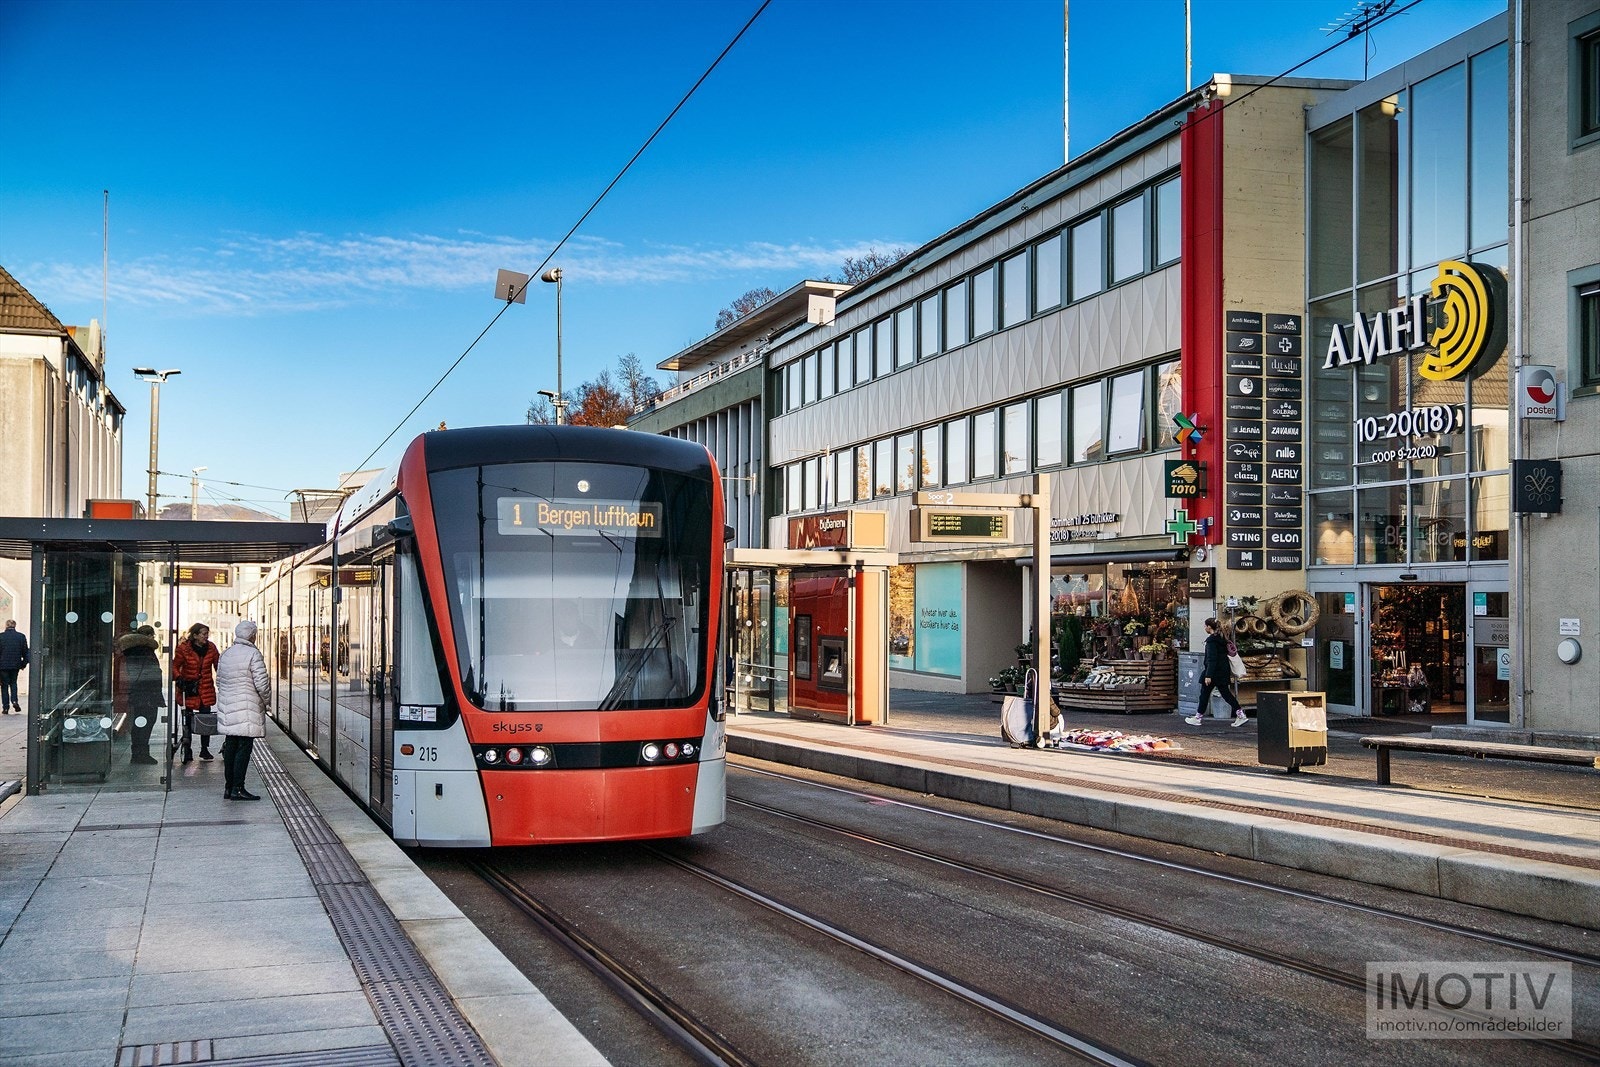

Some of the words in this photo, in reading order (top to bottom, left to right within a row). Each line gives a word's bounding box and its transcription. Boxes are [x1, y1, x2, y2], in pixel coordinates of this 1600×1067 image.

[1322, 294, 1428, 369] AMFI
[1526, 406, 1556, 416] posten
[1357, 404, 1453, 442] 10-20(18)
[1276, 447, 1296, 458] nille
[1372, 450, 1396, 462] COOP
[1398, 446, 1436, 460] 9-22(20)
[1271, 468, 1299, 478] AERLY
[1171, 484, 1197, 494] TOTO
[946, 493, 954, 504] 2
[513, 504, 522, 526] 1
[538, 503, 590, 530] Bergen
[594, 505, 654, 528] lufthavn
[1232, 533, 1260, 542] STING
[492, 721, 532, 734] skyss
[420, 746, 438, 762] 215
